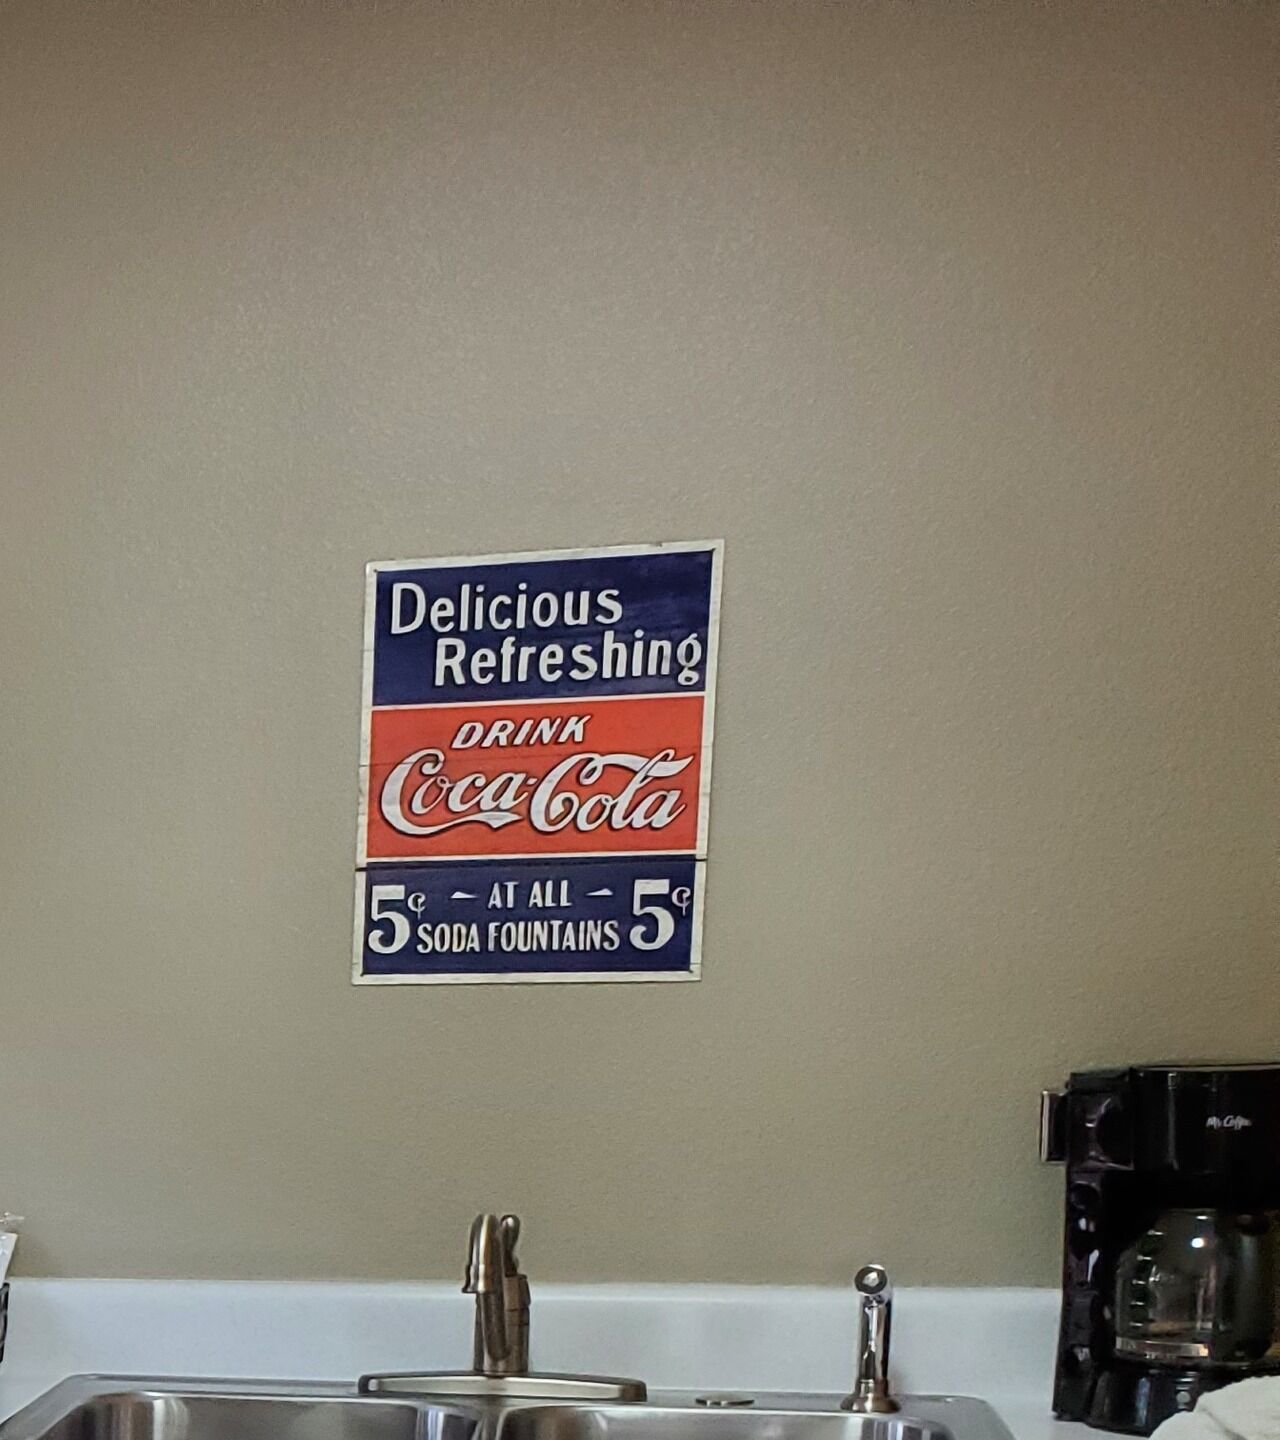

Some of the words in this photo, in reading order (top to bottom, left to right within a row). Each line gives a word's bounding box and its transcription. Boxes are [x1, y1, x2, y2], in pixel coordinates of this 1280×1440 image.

[390, 582, 623, 635] Delicious
[435, 629, 703, 686] Refreshing
[451, 715, 592, 749] DRINK
[381, 748, 695, 836] Coca-Cola
[487, 882, 518, 909] AT
[527, 880, 572, 908] ALL
[416, 923, 481, 953] SODA
[487, 920, 620, 953] FOUNTAINS
